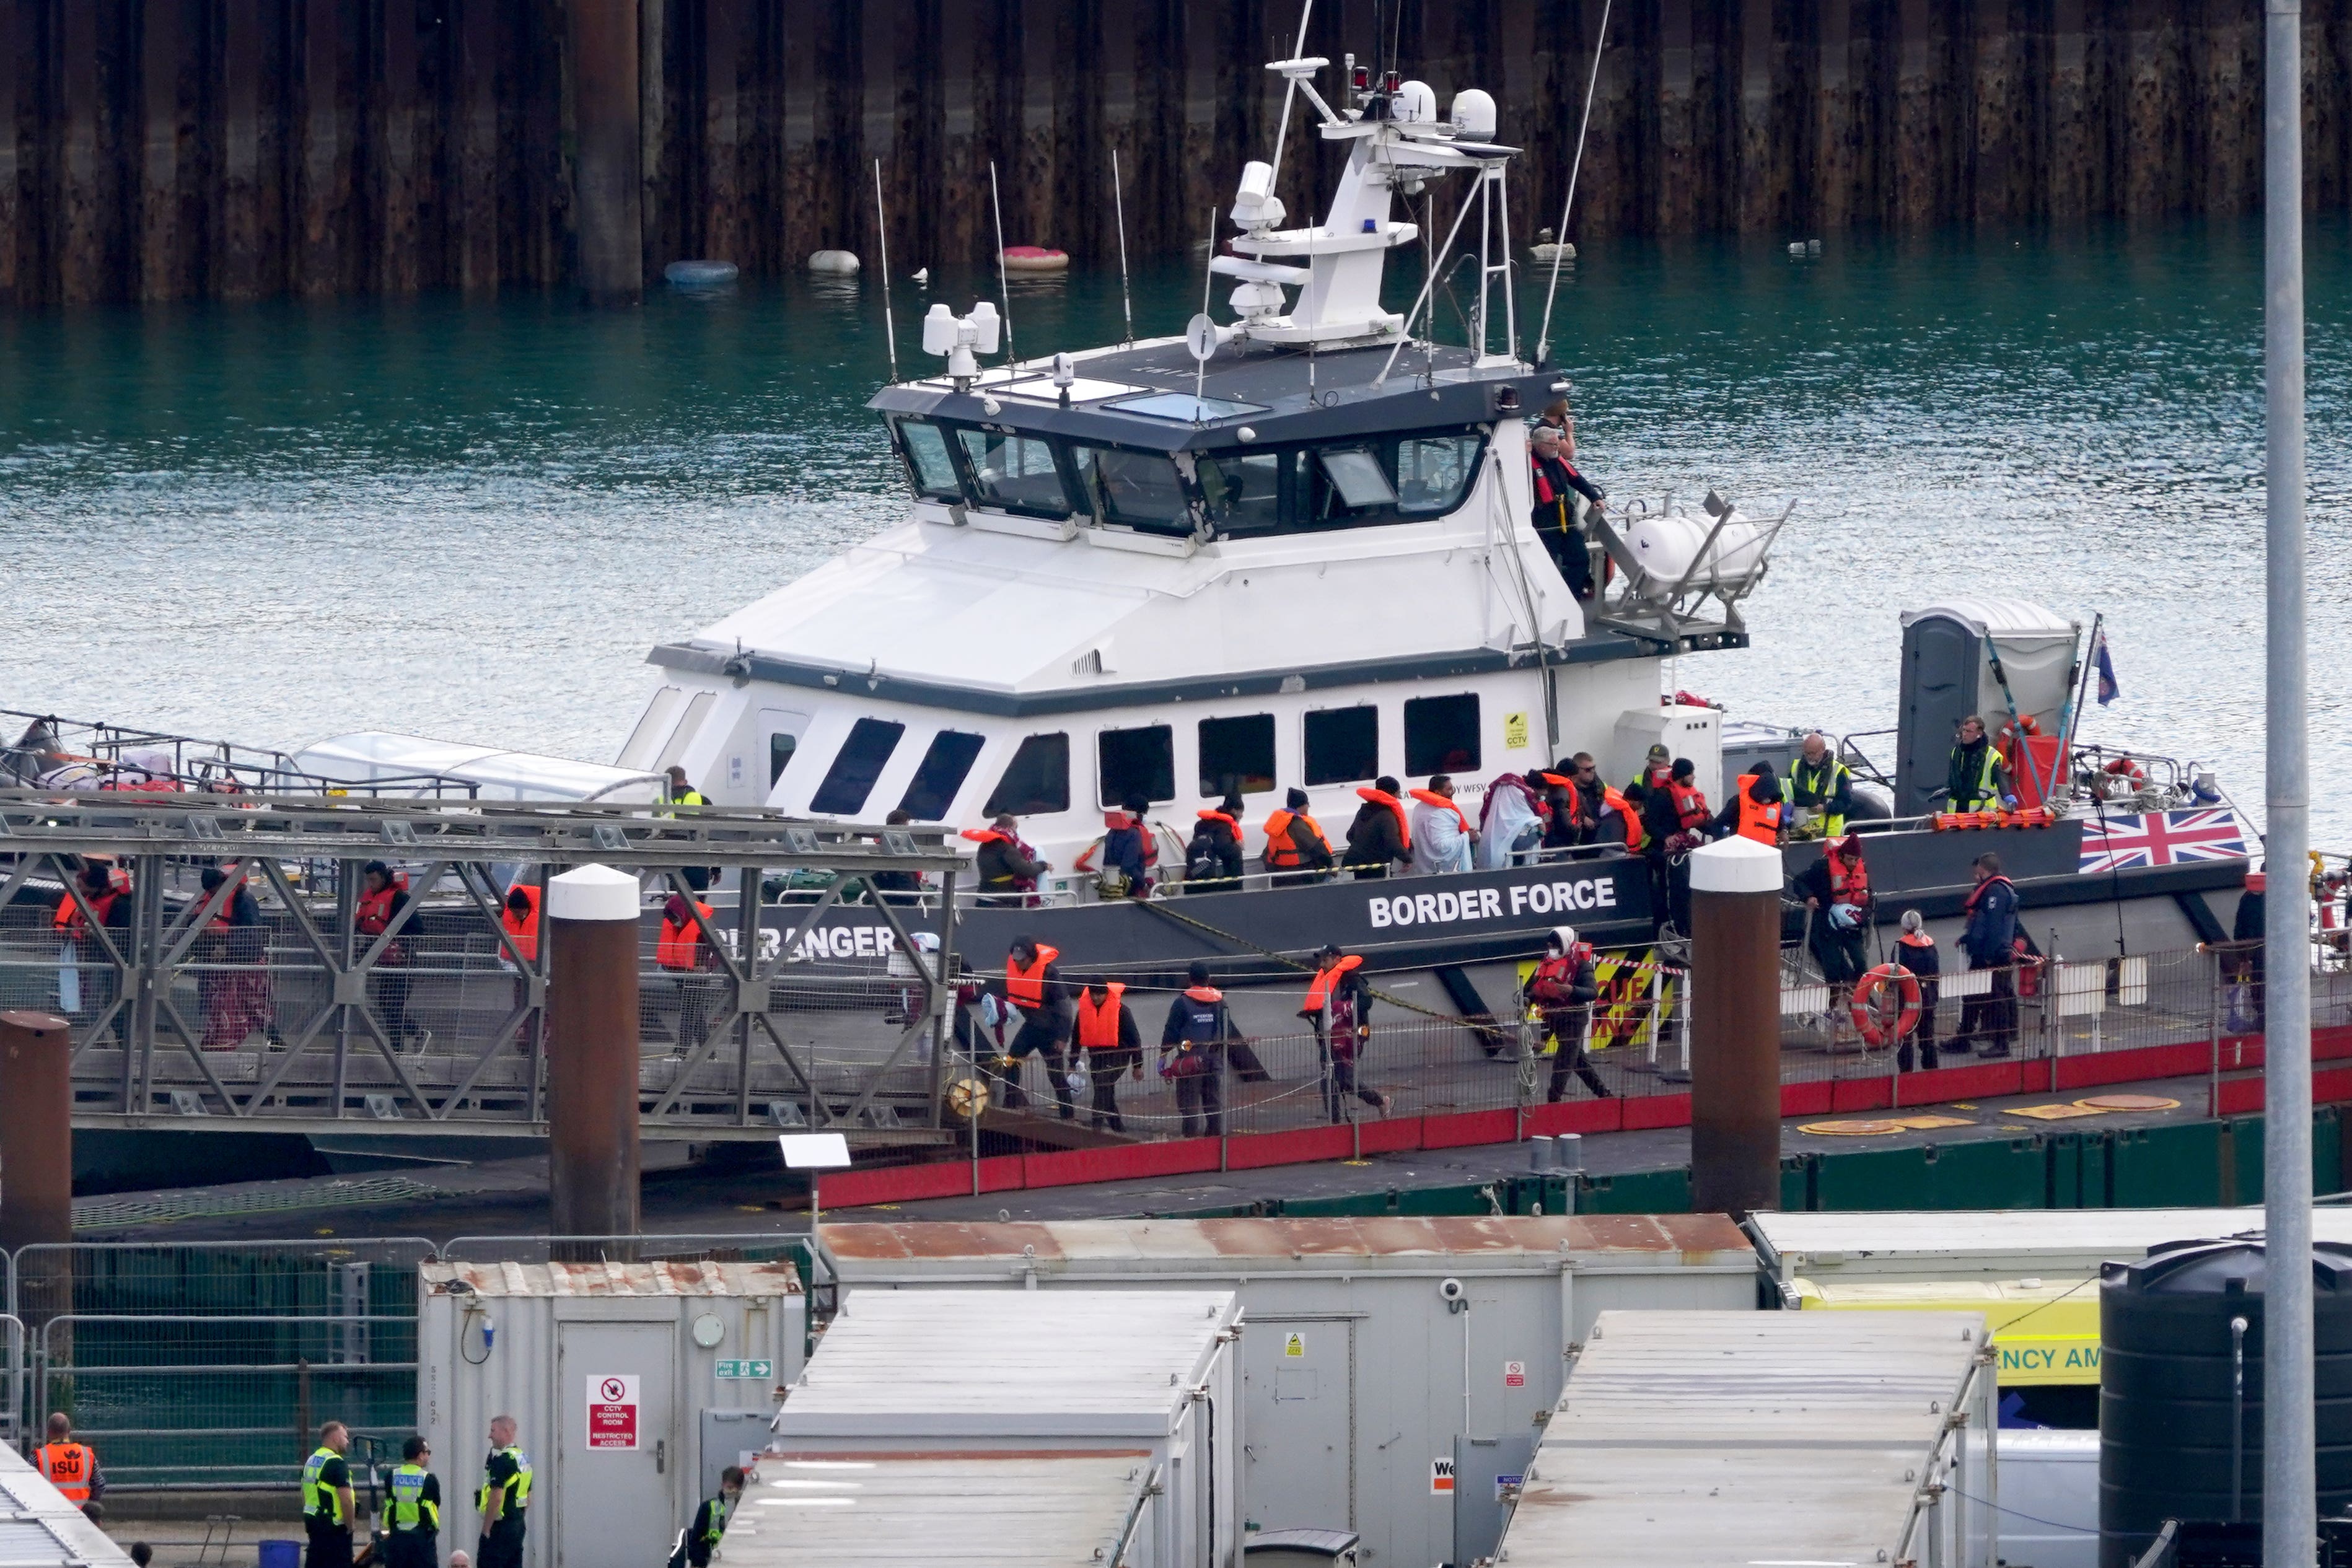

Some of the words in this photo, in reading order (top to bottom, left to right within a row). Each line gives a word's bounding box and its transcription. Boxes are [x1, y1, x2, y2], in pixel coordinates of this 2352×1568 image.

[1507, 735, 1527, 745] CCTV
[1463, 782, 1486, 793] WFSV
[1368, 888, 1504, 928] BORDER
[1509, 877, 1617, 916] FORCE
[1997, 1349, 2056, 1370] NCY
[52, 1461, 79, 1474] ISU
[393, 1476, 424, 1486] POLICE
